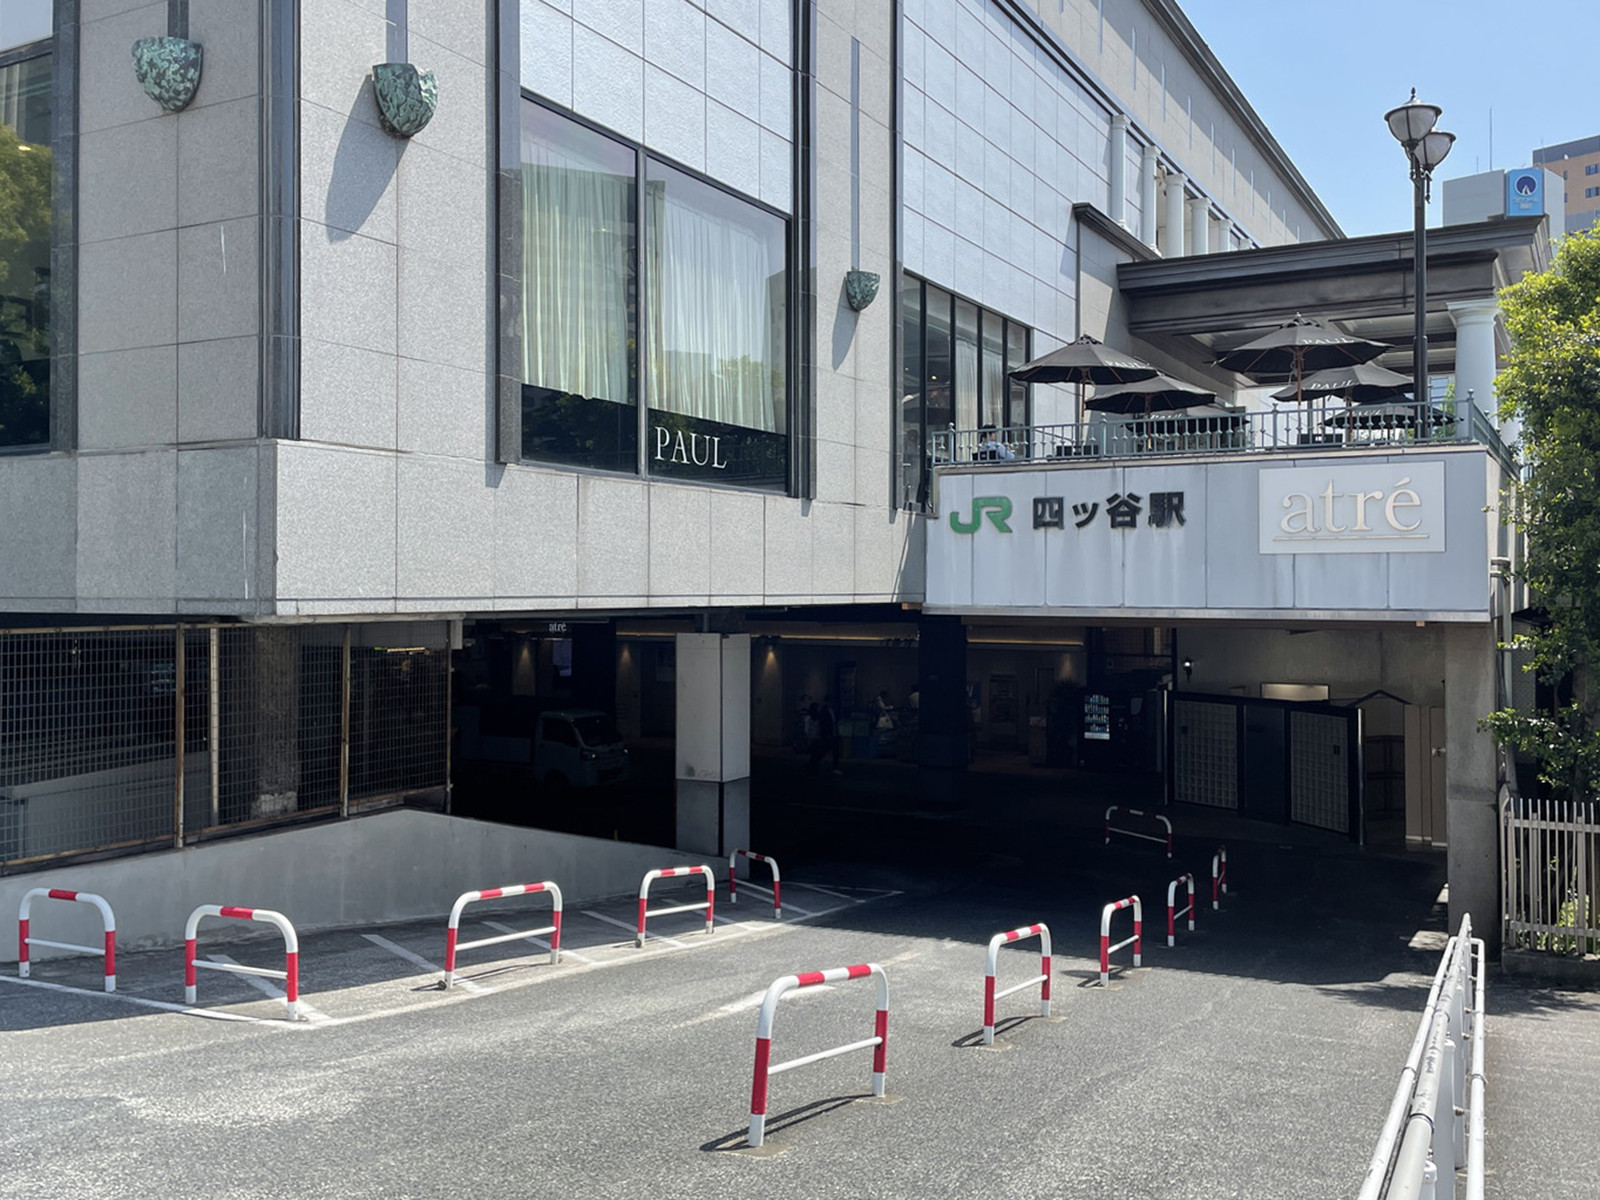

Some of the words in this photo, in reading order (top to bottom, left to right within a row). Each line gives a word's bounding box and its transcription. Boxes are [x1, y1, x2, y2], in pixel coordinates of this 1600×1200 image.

[654, 426, 727, 469] PAUL
[949, 496, 1013, 535] JR
[1032, 491, 1186, 530] 四ッ谷駅
[1280, 477, 1422, 534] atré
